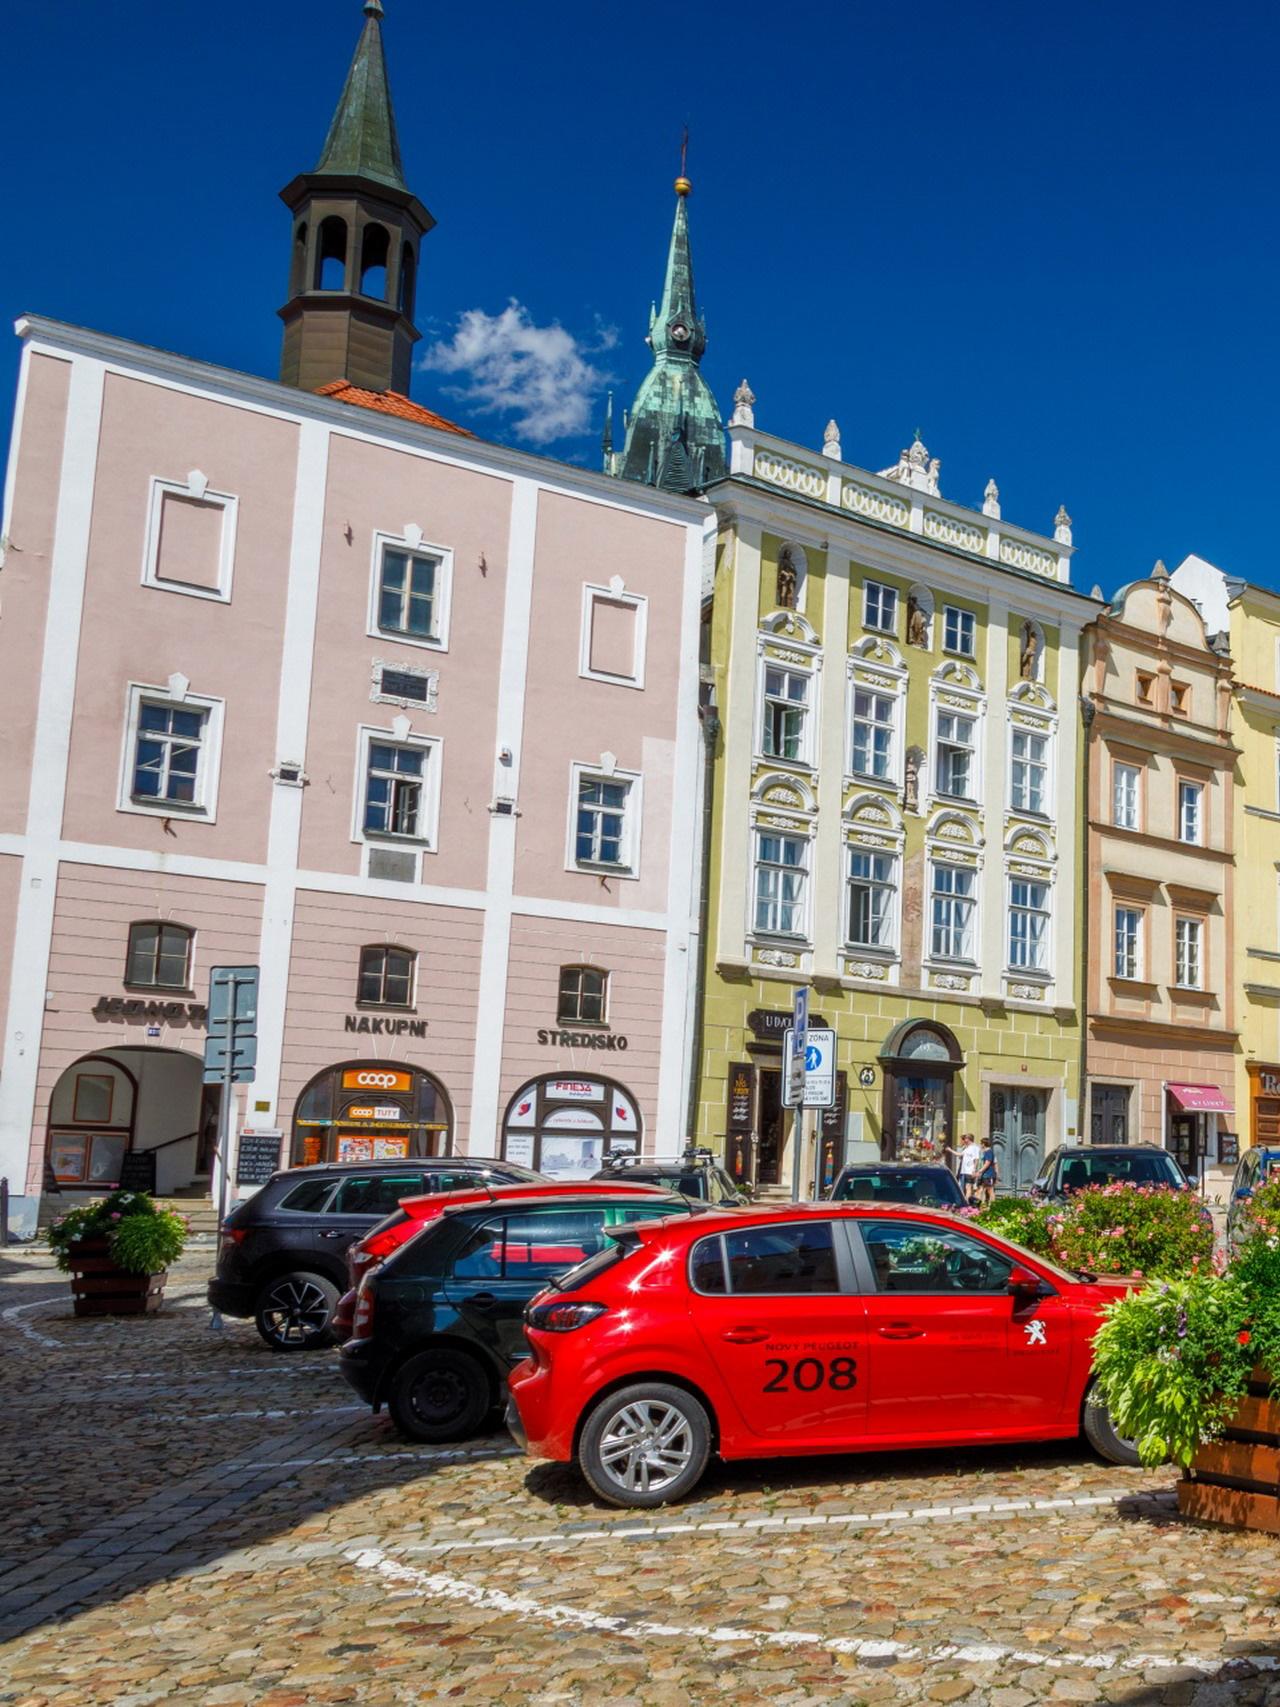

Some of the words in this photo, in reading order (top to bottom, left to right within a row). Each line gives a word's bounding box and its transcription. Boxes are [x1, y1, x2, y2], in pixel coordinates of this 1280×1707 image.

[92, 997, 208, 1025] JEDNOT
[357, 1072, 397, 1088] coop
[803, 1341, 859, 1351] PEUGEOT
[762, 1356, 858, 1393] 208
